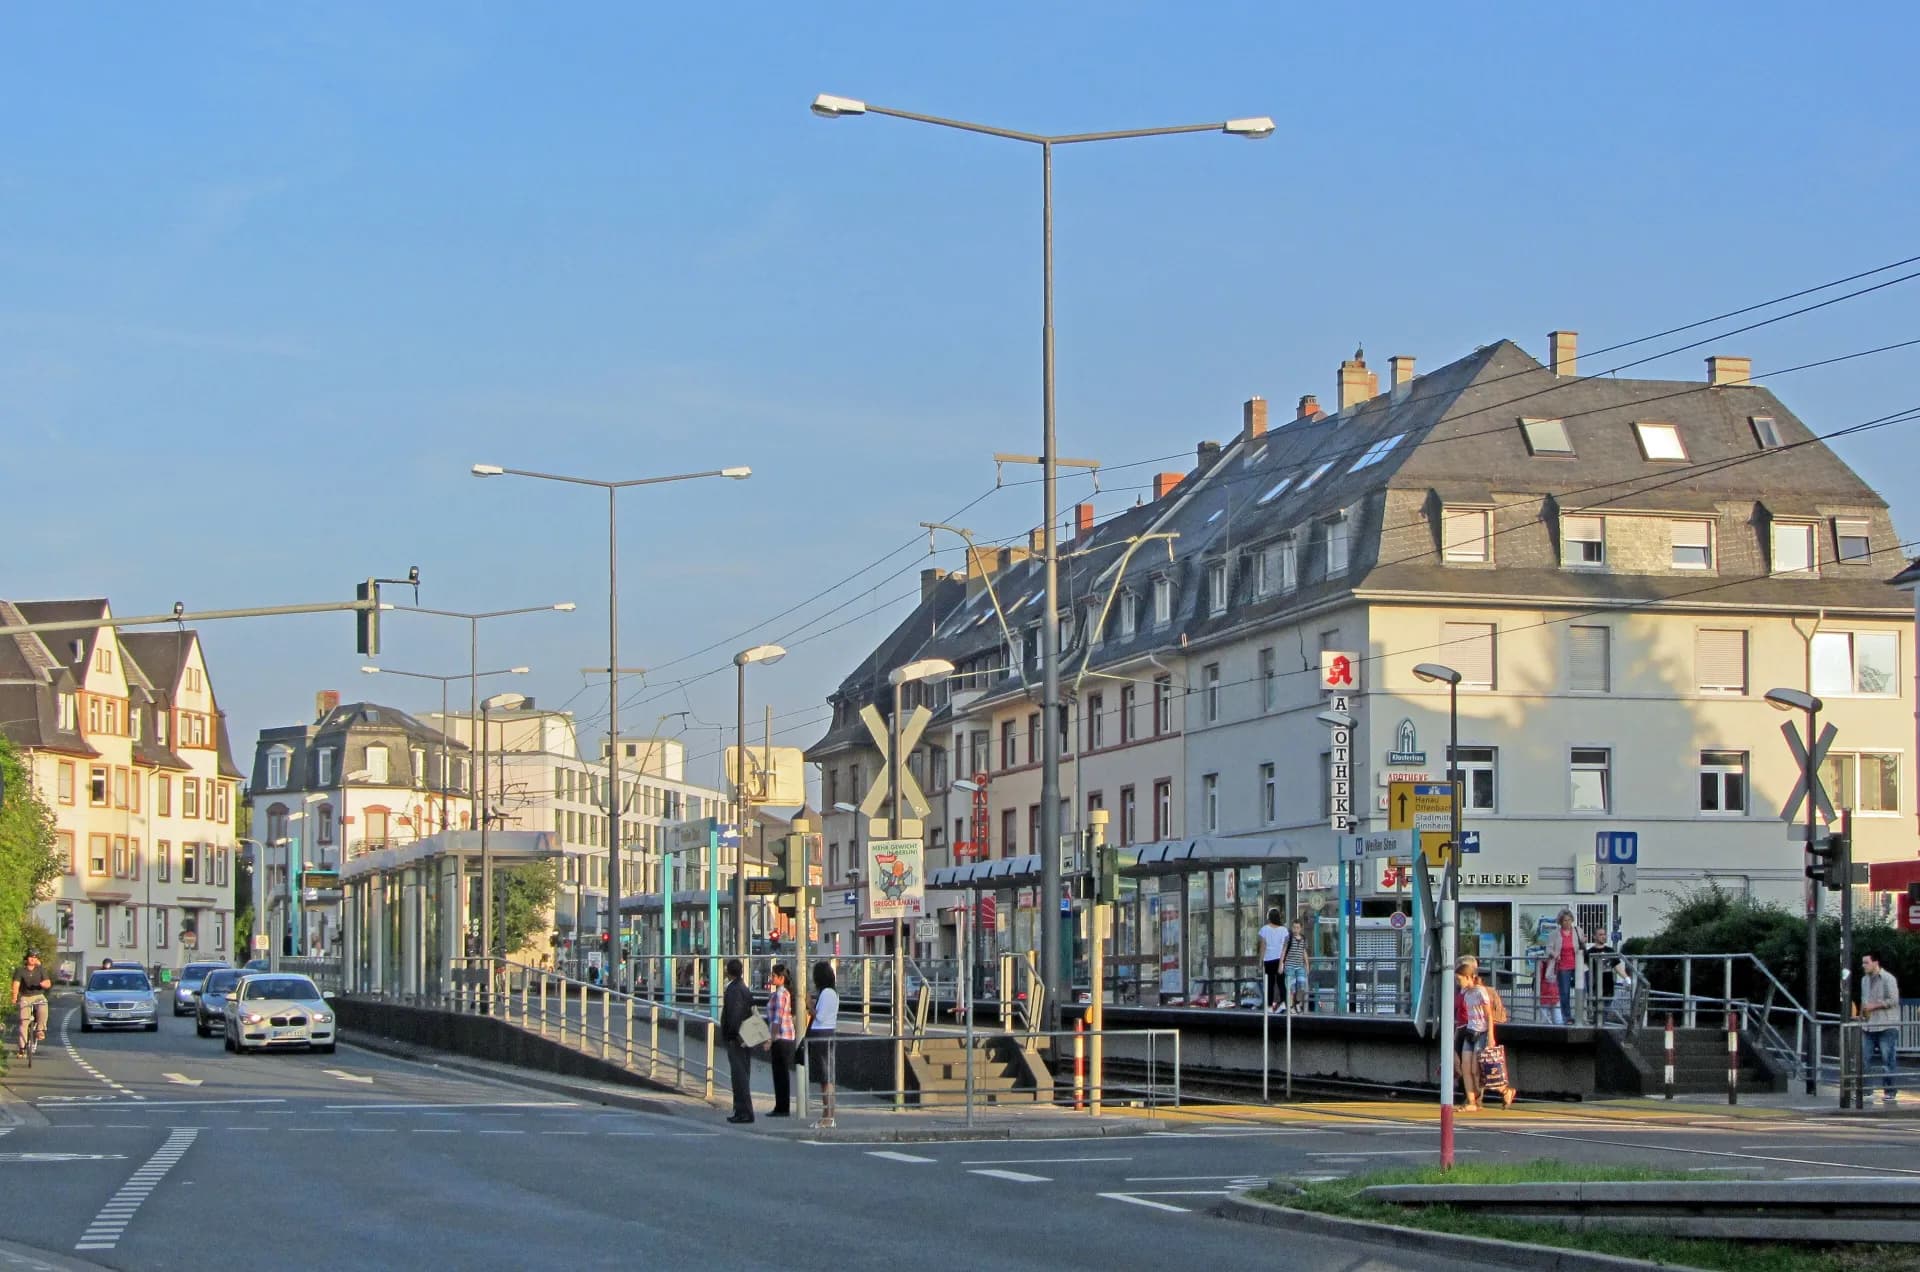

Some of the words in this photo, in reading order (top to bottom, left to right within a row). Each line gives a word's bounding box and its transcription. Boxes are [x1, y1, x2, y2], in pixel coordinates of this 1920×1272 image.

[1326, 655, 1353, 686] A
[1335, 697, 1349, 829] AOTHEKE
[1415, 795, 1439, 804] Hanau
[1415, 813, 1452, 821] Stadtmitt
[1383, 837, 1397, 850] Stein
[1598, 837, 1609, 860] U
[1614, 837, 1633, 860] U
[1440, 873, 1530, 884] OTHEKE
